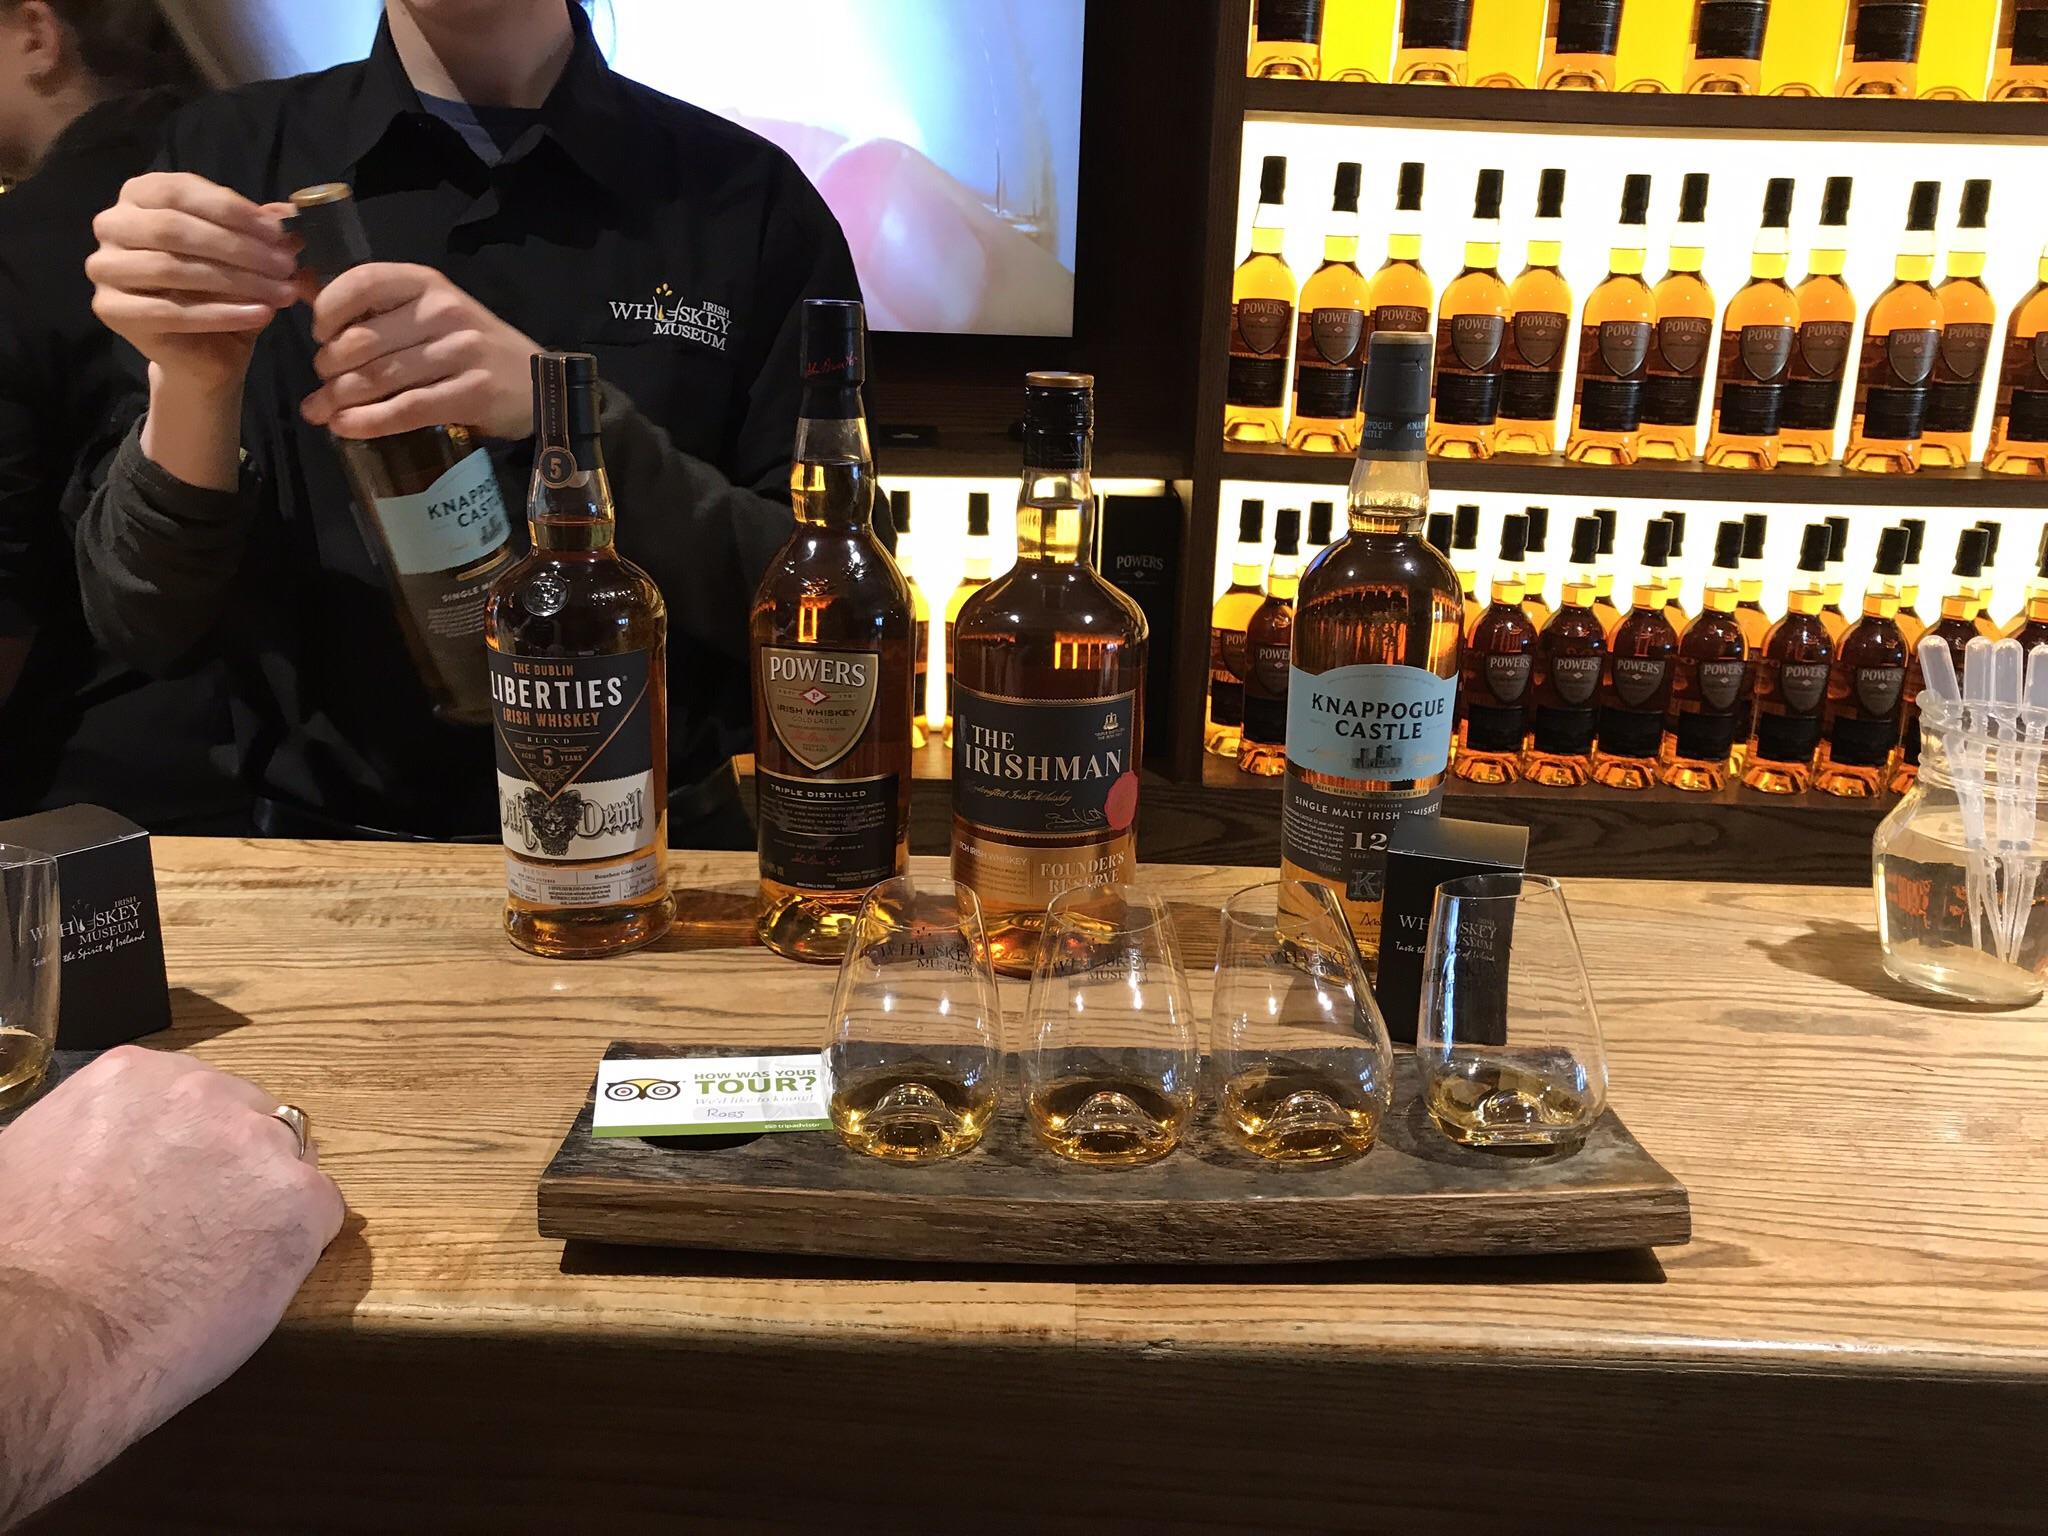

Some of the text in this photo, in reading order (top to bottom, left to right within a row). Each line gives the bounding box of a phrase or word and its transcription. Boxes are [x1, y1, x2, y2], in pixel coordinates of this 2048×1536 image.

[608, 298, 732, 335] WHISKEY
[702, 301, 730, 319] IRISH
[1243, 303, 1285, 316] POWERS
[1381, 308, 1422, 323] POWERS
[1520, 315, 1562, 329] POWERS
[1665, 320, 1708, 334] POWERS
[653, 322, 727, 351] MUSEUM
[1807, 325, 1849, 338] POWERS
[550, 457, 562, 480] 5
[1116, 555, 1164, 570] POWERS
[442, 586, 479, 602] SINGLE
[1260, 648, 1291, 660] POWE
[513, 662, 574, 676] THE DUBLIN
[1490, 656, 1531, 669] POWERS
[1557, 658, 1599, 672] POWERS
[1617, 659, 1660, 675] POWERS
[1703, 663, 1744, 676] POWERS
[770, 656, 866, 687] POWERS
[1785, 665, 1828, 679] POWERS
[1861, 669, 1902, 682] POWERS
[491, 671, 622, 710] LIBERTIES
[811, 692, 820, 700] P
[777, 704, 858, 717] IRISH WHISKEY
[1311, 692, 1444, 719] KNAPPOGUE
[503, 707, 600, 728] IRISH WHISKEY
[971, 724, 1015, 751] THE
[1335, 720, 1422, 740] CASTLE
[527, 736, 570, 744] BLEND
[543, 748, 553, 766] 5
[965, 743, 1122, 782] IRISHMAN
[770, 784, 867, 799] TRIPLE DISTILLED
[576, 787, 644, 838] Devil
[1295, 795, 1328, 814] SINGLE
[1332, 809, 1363, 820] MALT
[1367, 810, 1401, 821] IRISH
[1350, 832, 1387, 851] 12
[988, 853, 1028, 865] WHISKEY
[1040, 851, 1125, 877] FOUNDER'S
[1049, 869, 1119, 893] RESERVE
[1354, 871, 1376, 896] K
[114, 896, 137, 908] IRISH
[79, 918, 140, 945] MUSEUM
[62, 950, 76, 963] the
[78, 944, 103, 960] Spirit
[105, 940, 114, 952] of
[115, 930, 145, 948] Ireland
[1395, 941, 1414, 952] Taste
[917, 958, 974, 977] MUSEUM
[694, 1069, 816, 1080] HOW WAS YOUR
[695, 1077, 817, 1094] TOUR?
[707, 1108, 745, 1119] Ross
[778, 1122, 821, 1130] tripadvisor
